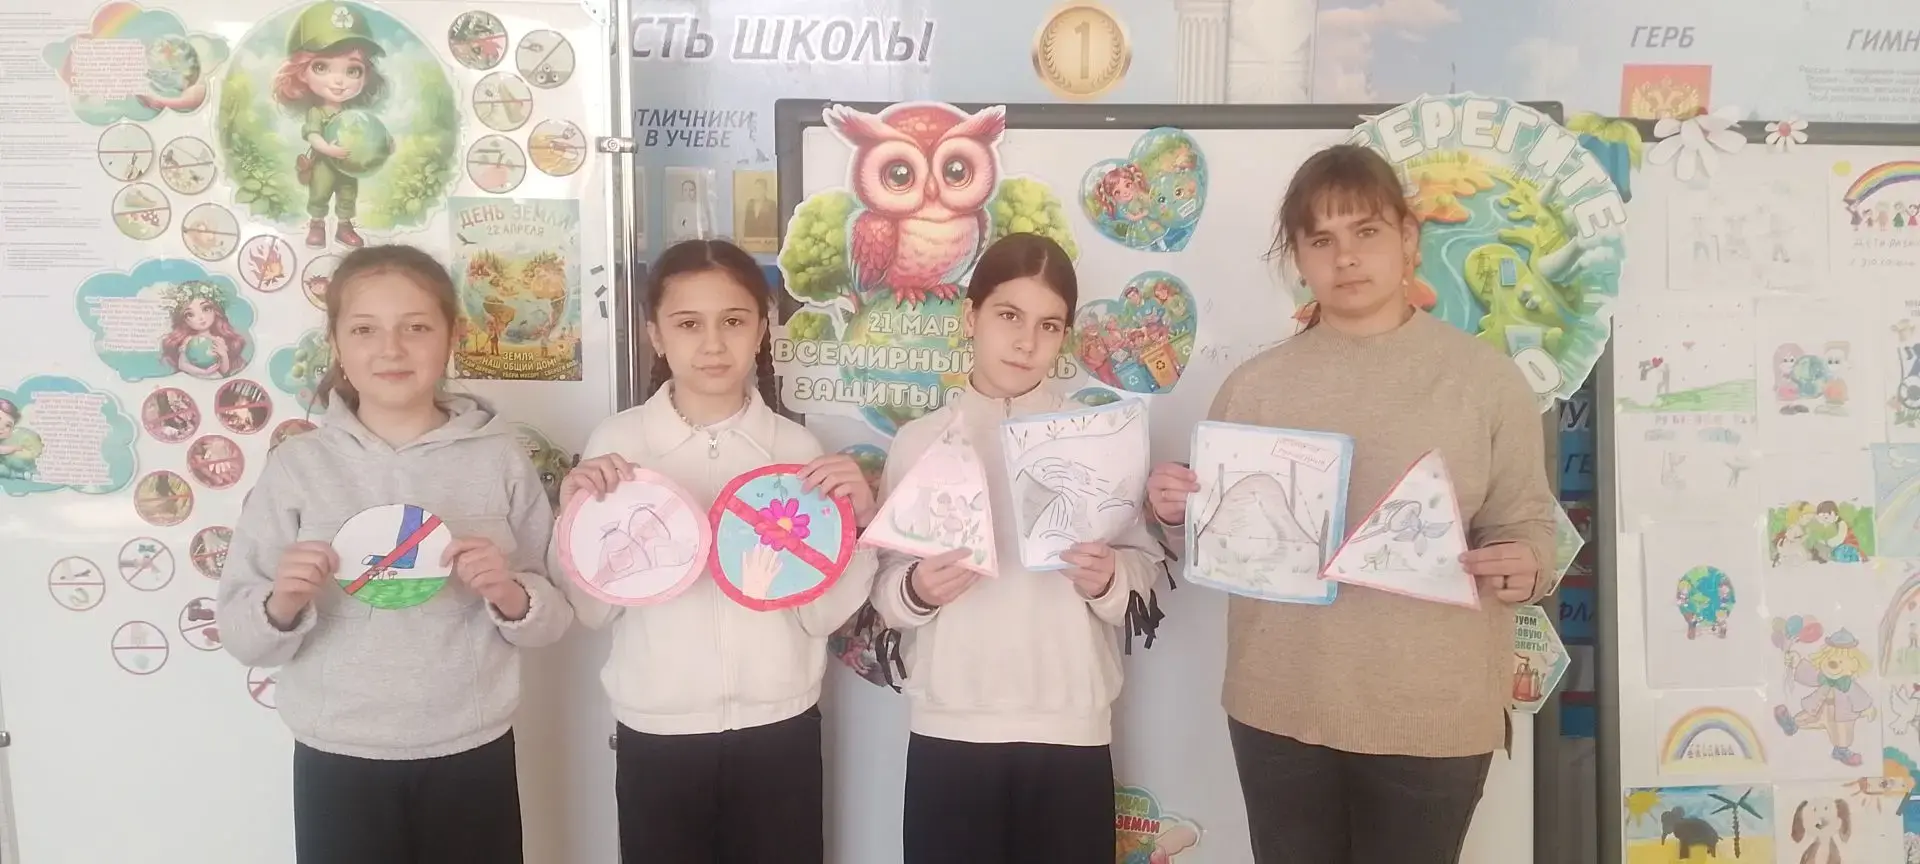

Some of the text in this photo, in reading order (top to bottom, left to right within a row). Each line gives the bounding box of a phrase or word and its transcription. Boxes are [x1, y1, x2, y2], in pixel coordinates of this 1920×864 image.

[632, 17, 935, 62] СТЬ ШКОЛЫ
[1629, 25, 1696, 50] ГЕРБ
[1846, 28, 1920, 52] ГИМН
[635, 108, 752, 128] ТЛИЧНИКИ
[645, 130, 731, 148] В УЧЕБЕ
[458, 203, 572, 230] ДЕНЬ ЗЕМЛИ
[503, 224, 545, 237] АПРЕЛЯ
[869, 311, 962, 338] 21 МАР
[481, 357, 557, 372] НАШ ОБЩИЙ ДОМ!
[502, 351, 534, 361] ЗЕМЛЯ
[794, 376, 938, 409] ЗАЩИТЫ
[1560, 601, 1594, 622] ФЛ
[1516, 628, 1542, 639] овую
[1115, 814, 1161, 834] ЗЕМЛИ
